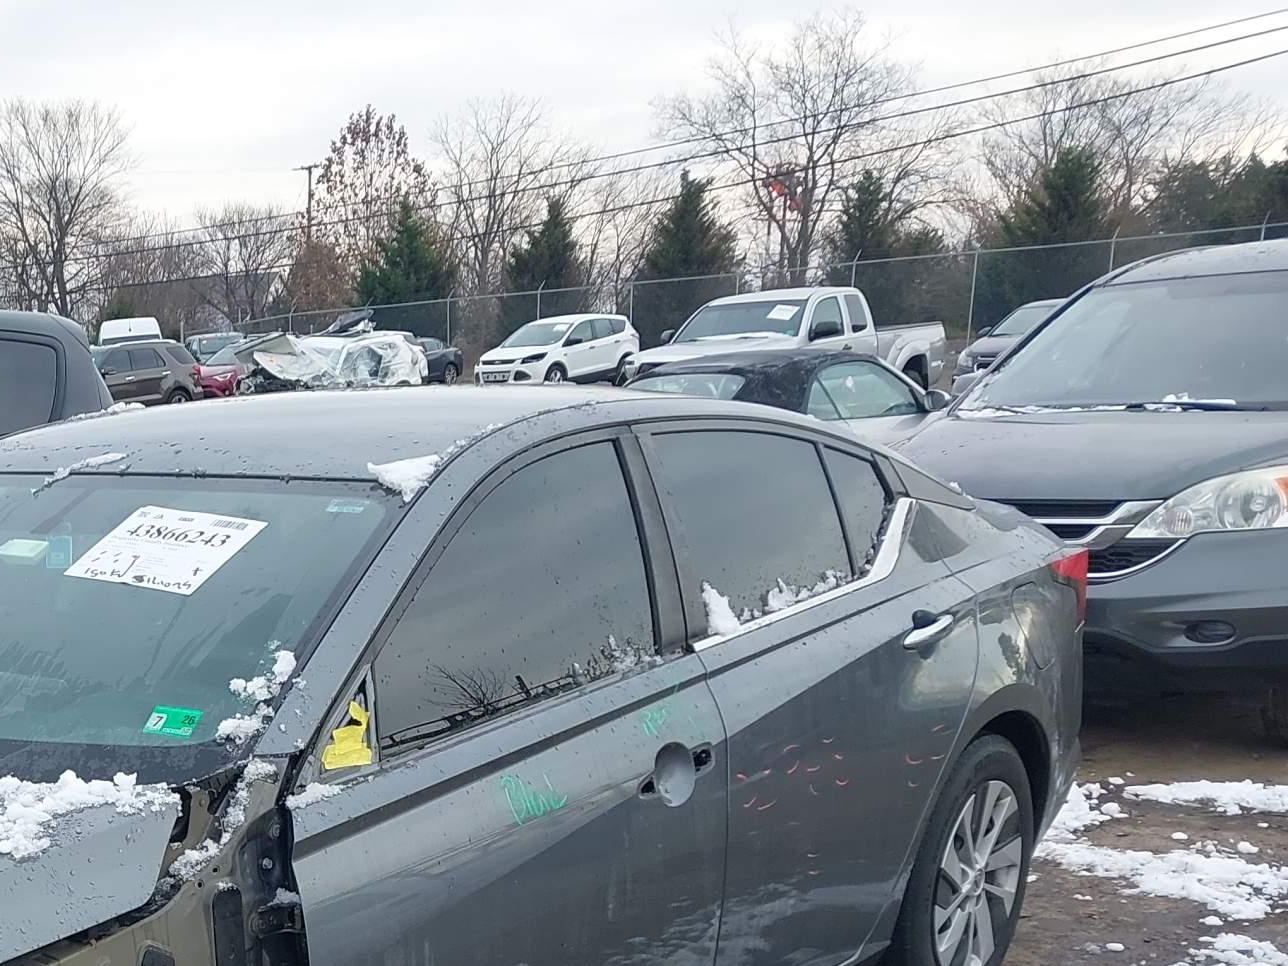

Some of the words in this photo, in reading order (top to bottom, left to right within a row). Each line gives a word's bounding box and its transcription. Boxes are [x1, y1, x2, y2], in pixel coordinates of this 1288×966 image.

[127, 523, 232, 548] 43866243
[152, 715, 164, 727] 7
[181, 714, 197, 726] 26
